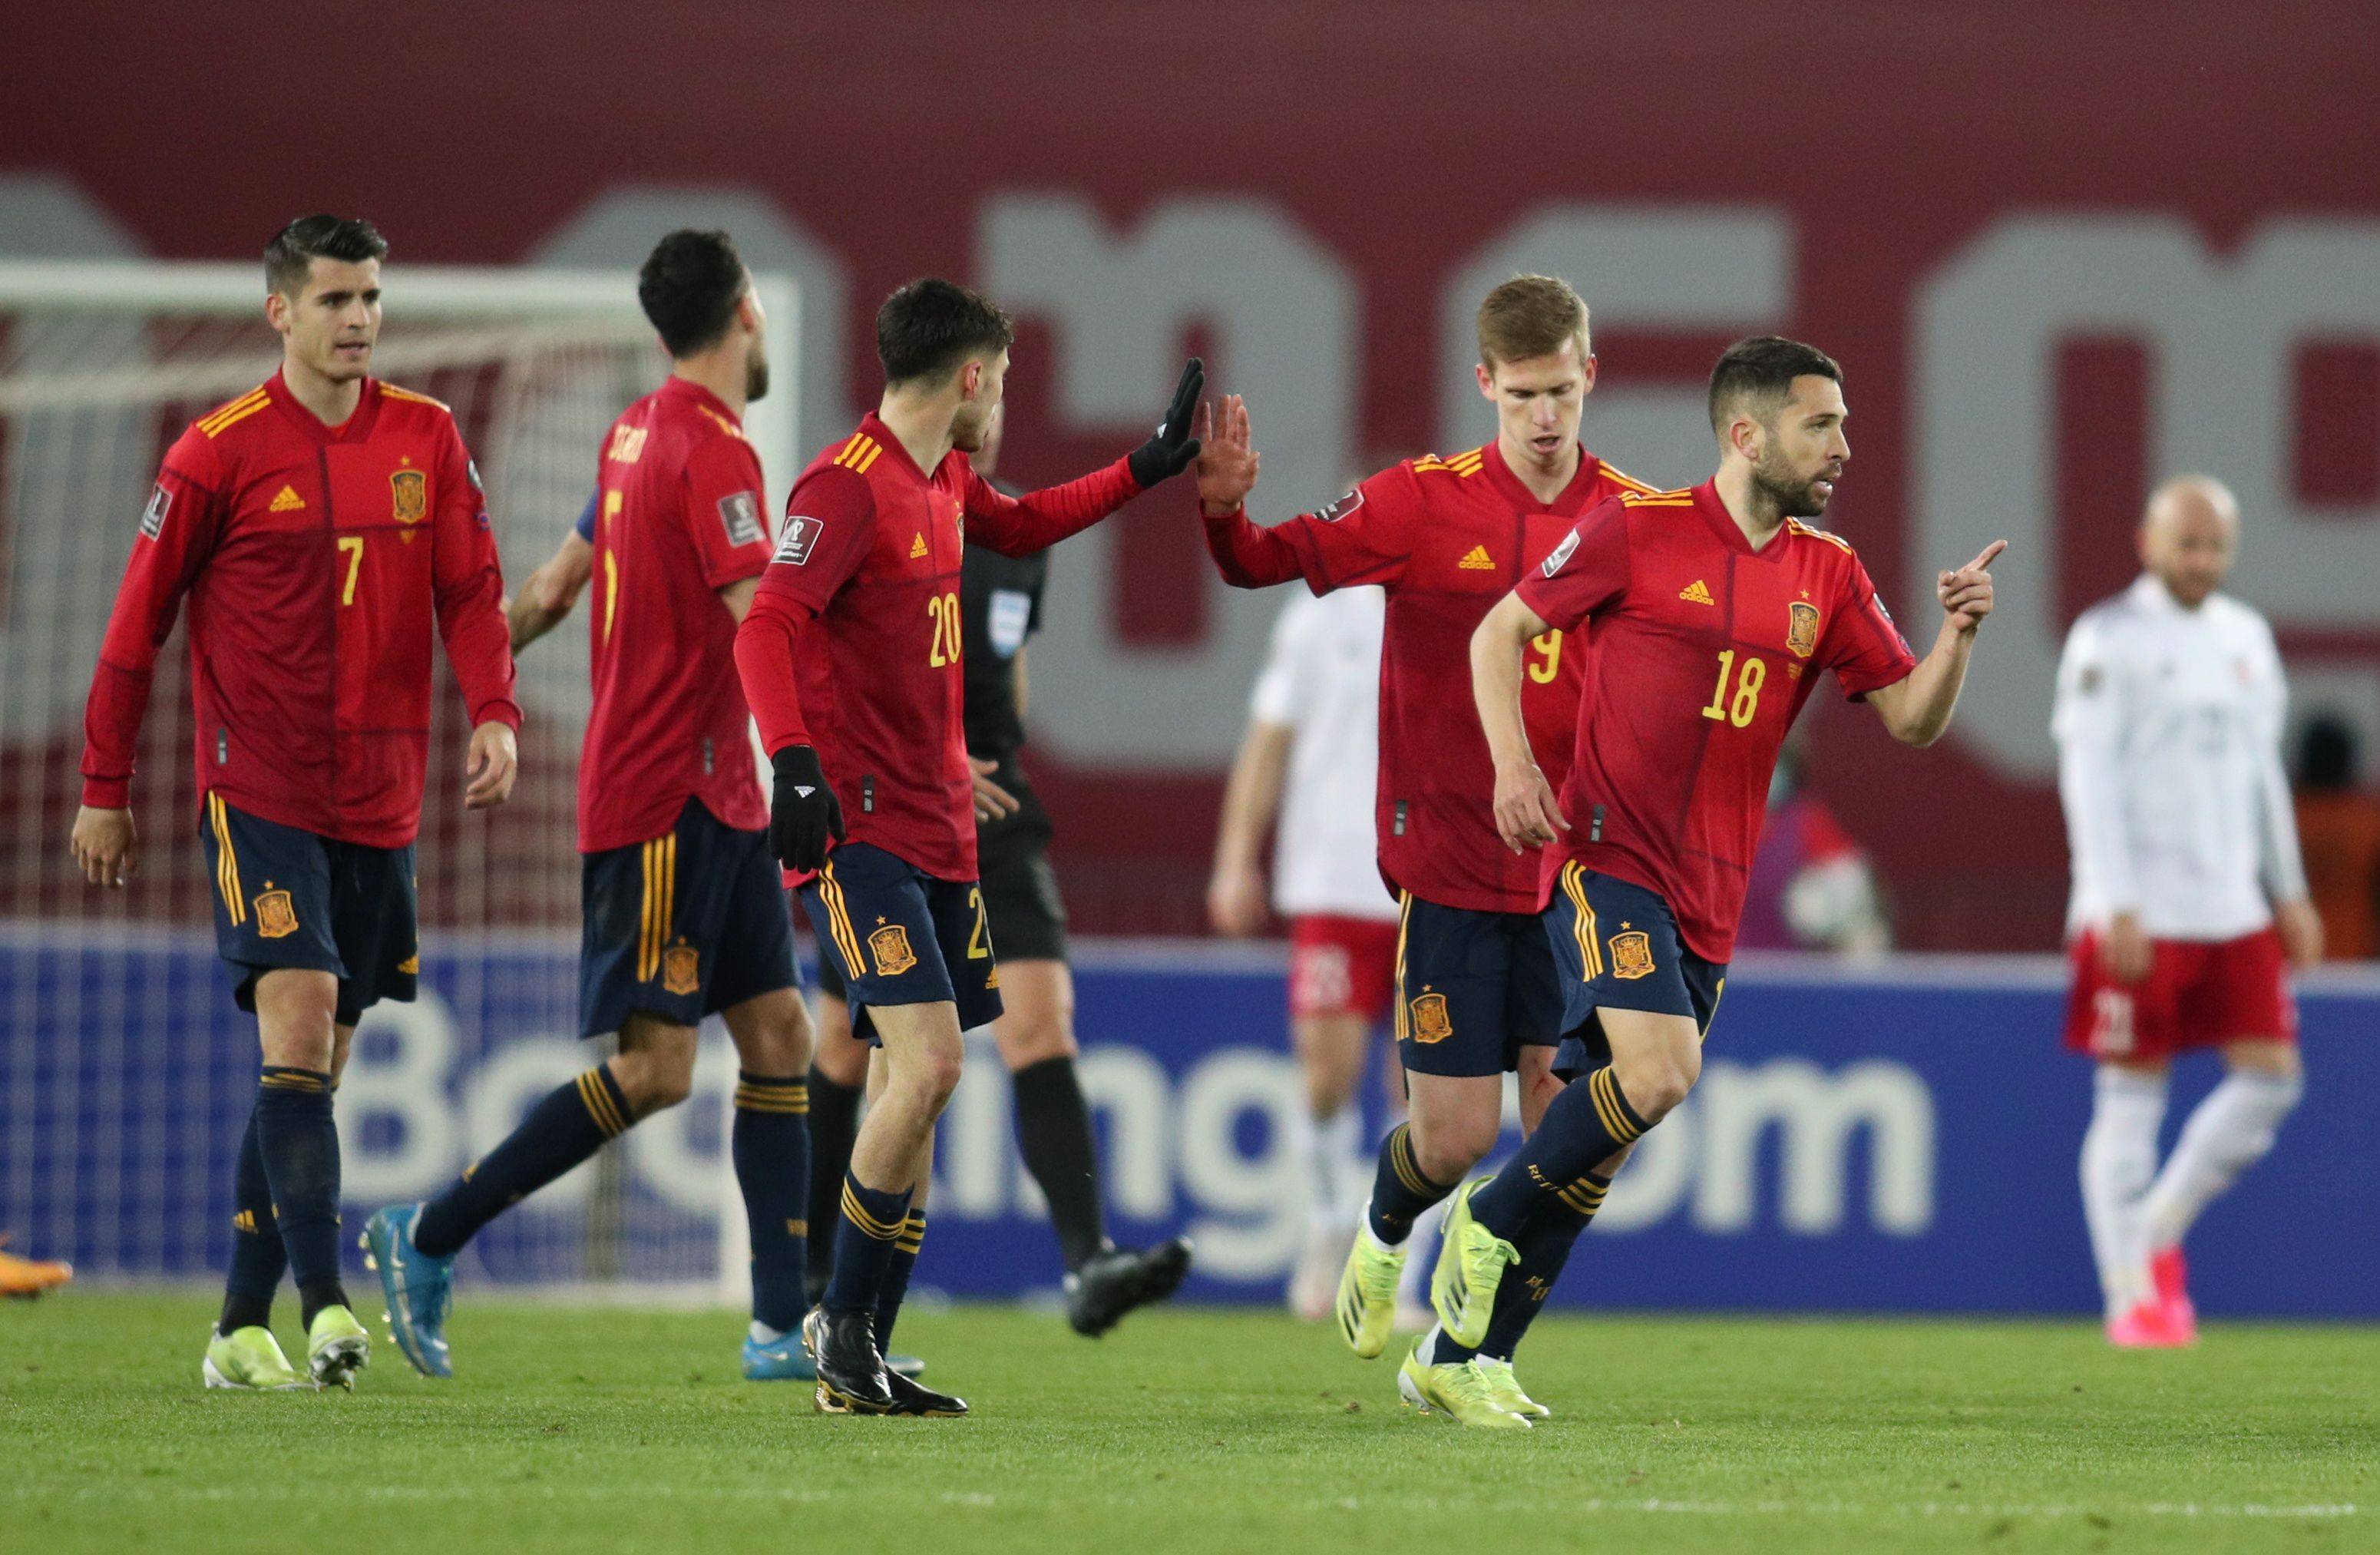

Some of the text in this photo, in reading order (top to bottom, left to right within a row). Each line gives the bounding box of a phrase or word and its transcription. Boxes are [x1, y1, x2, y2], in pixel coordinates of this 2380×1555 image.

[339, 536, 364, 605] 7
[910, 548, 928, 559] adidas
[1459, 561, 1496, 570] adidas
[928, 593, 962, 668] 20
[1679, 592, 1714, 606] adidas
[1529, 628, 1563, 683] 9
[1702, 650, 1766, 728] 18
[967, 887, 996, 965] 2
[336, 996, 1935, 1281] Booingom
